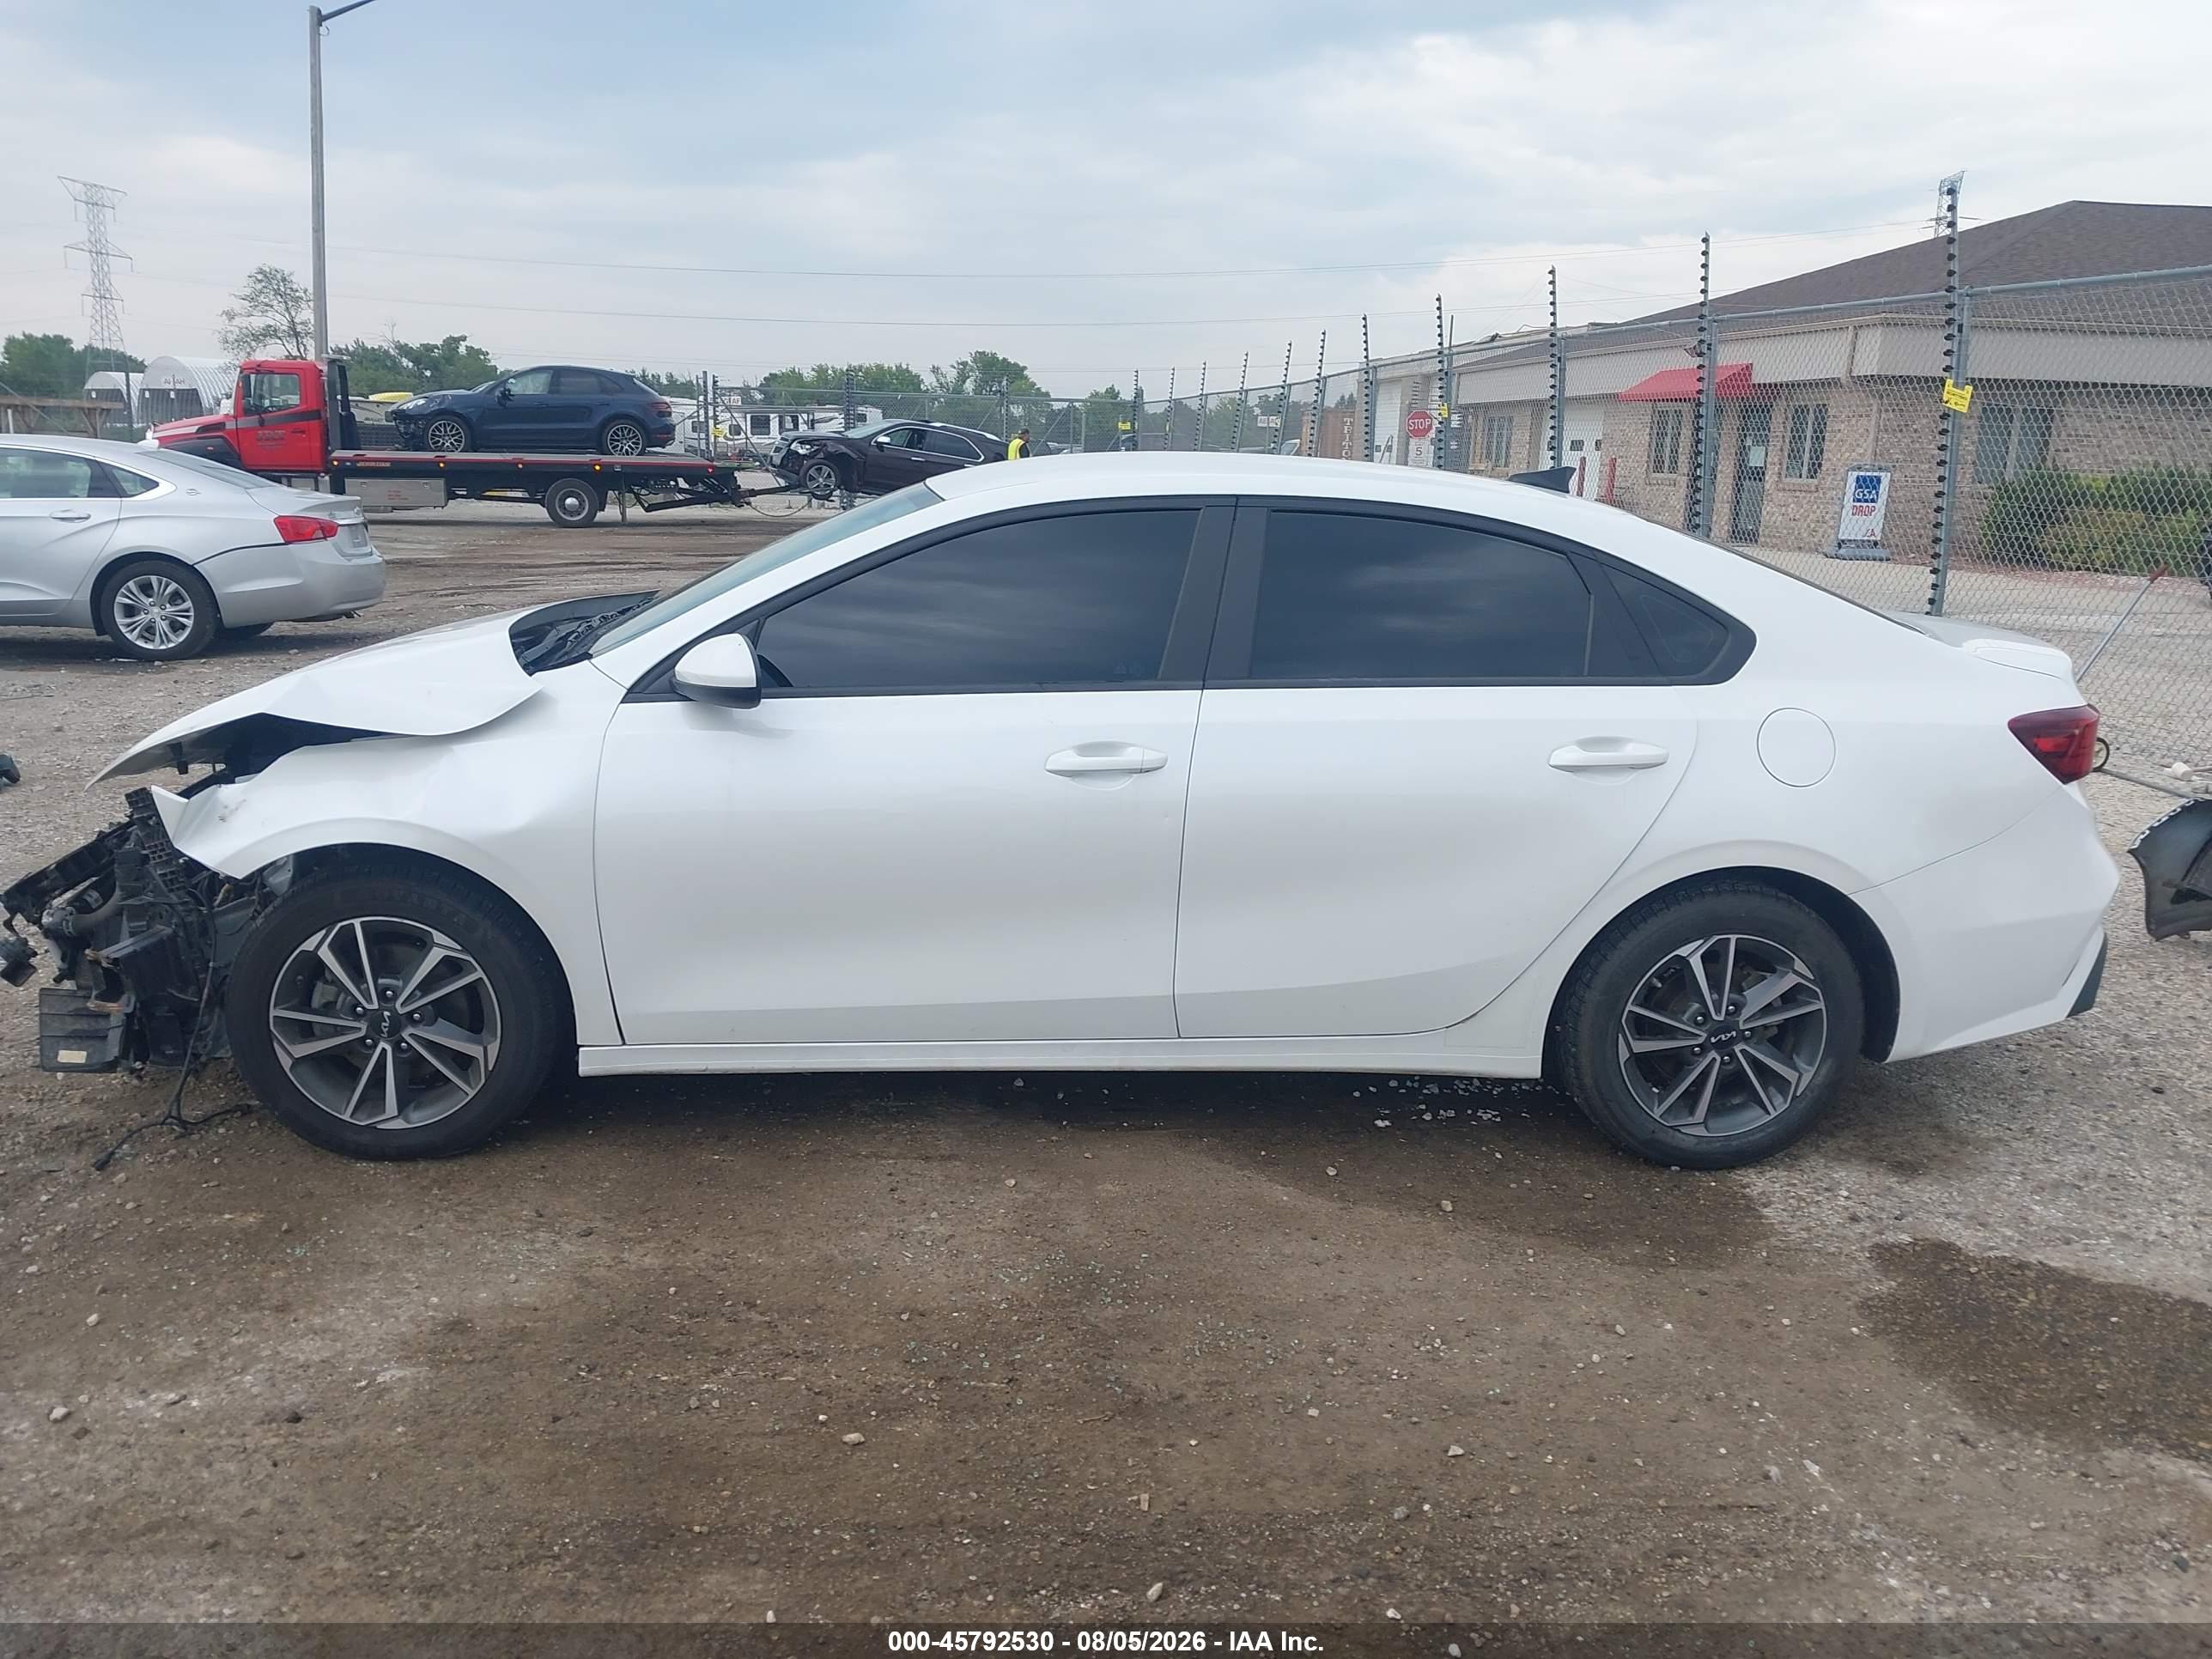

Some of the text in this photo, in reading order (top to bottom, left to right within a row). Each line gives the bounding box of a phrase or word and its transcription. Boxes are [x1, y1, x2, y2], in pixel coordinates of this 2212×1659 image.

[1408, 418, 1431, 430] STOP
[1414, 447, 1423, 456] 5
[1855, 488, 1878, 500] GSA
[1851, 505, 1876, 517] DROP
